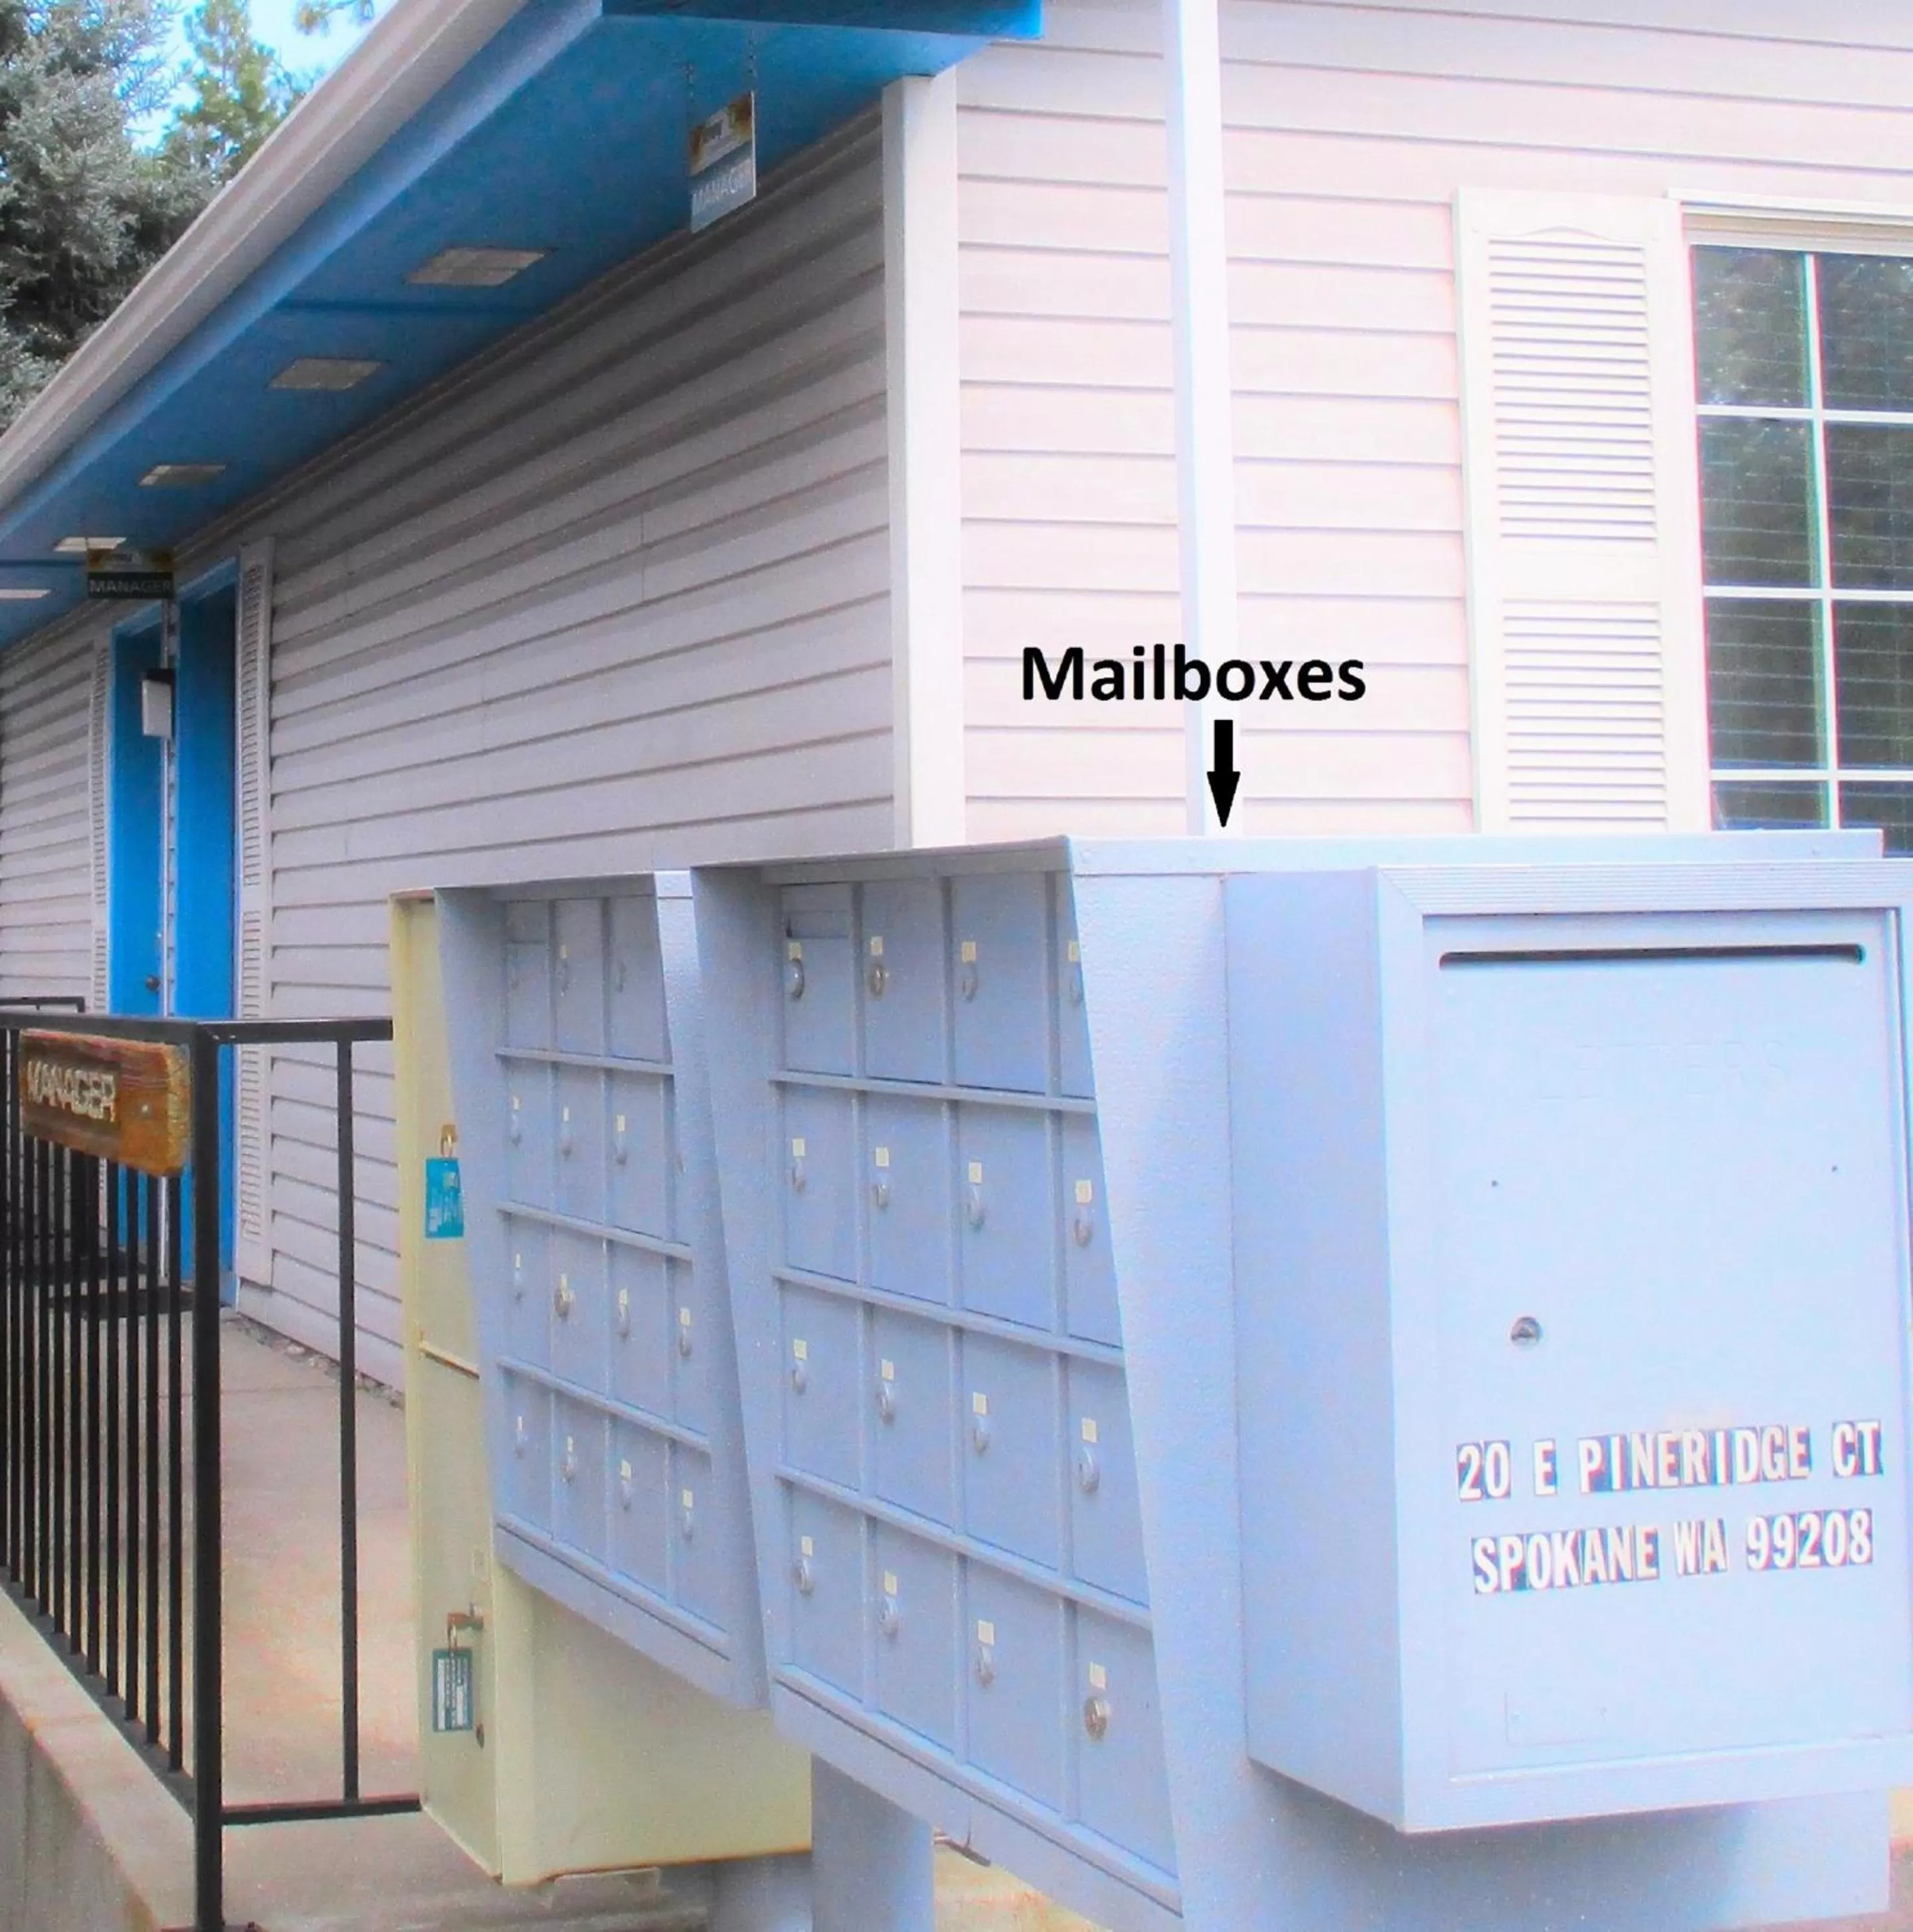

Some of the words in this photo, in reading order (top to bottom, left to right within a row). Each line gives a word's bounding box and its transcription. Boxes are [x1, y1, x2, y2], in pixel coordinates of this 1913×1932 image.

[691, 157, 753, 216] MANAG
[27, 1061, 116, 1122] MANAGER
[1457, 1440, 1510, 1501] 20
[1533, 1439, 1557, 1496] E
[1578, 1425, 1810, 1494] PINERIDGE
[1833, 1420, 1882, 1477] CT
[1471, 1526, 1659, 1594] SPOKANE
[1673, 1519, 1727, 1576] WA
[1747, 1508, 1872, 1571] 99208
